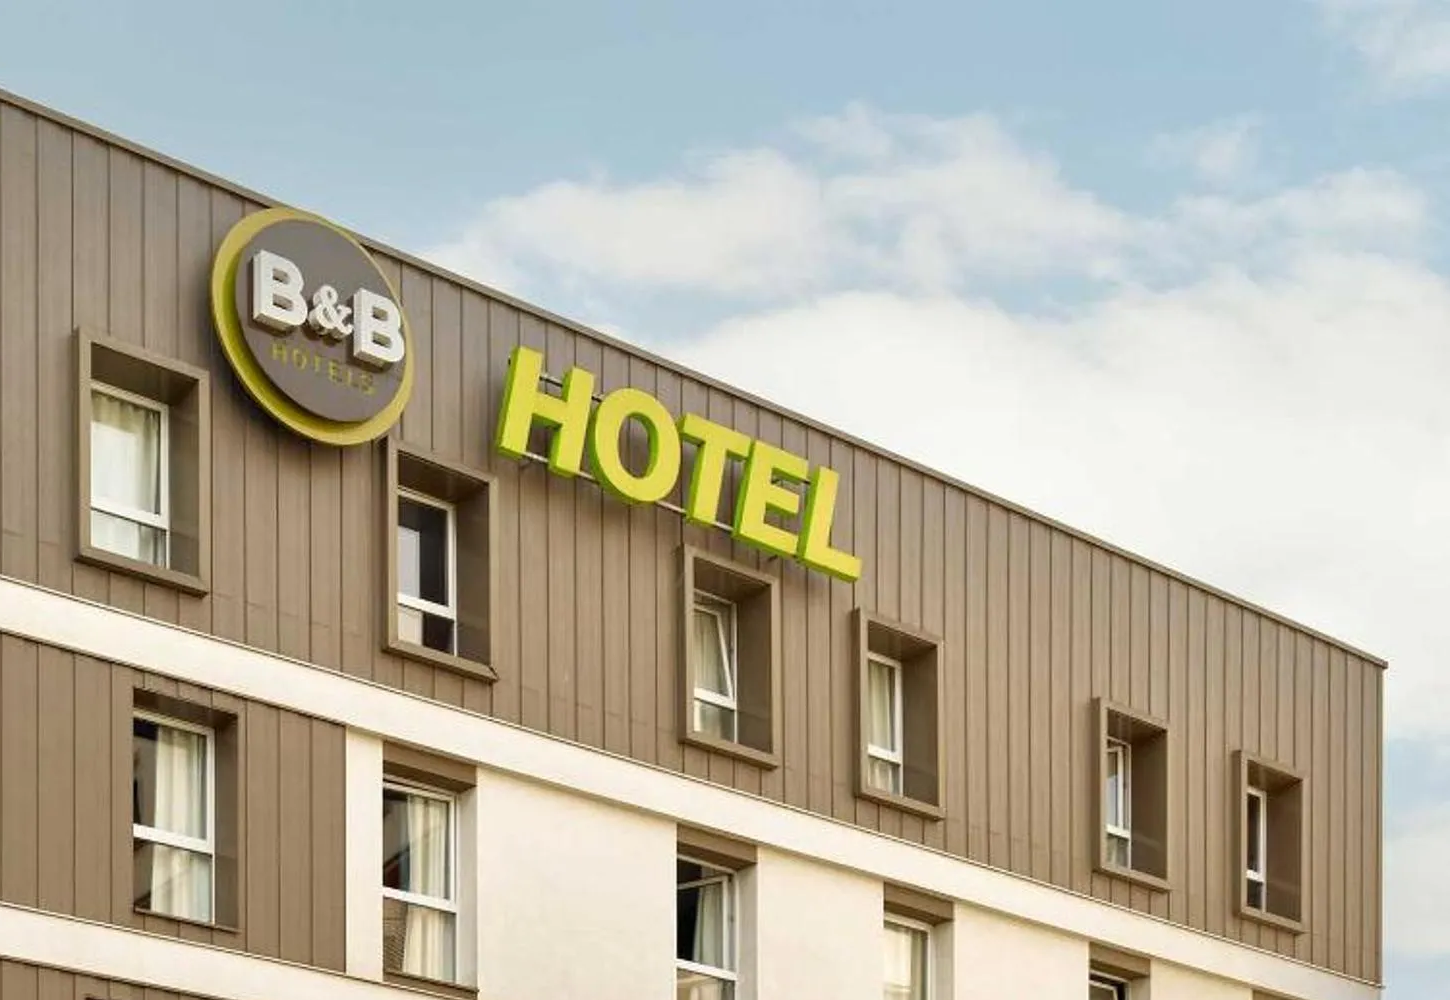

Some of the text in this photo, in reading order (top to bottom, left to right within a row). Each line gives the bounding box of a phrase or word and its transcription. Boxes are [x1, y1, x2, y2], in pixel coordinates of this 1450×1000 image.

[252, 249, 405, 369] B&B
[271, 341, 376, 396] HOTELS
[496, 345, 862, 583] HOTEL
